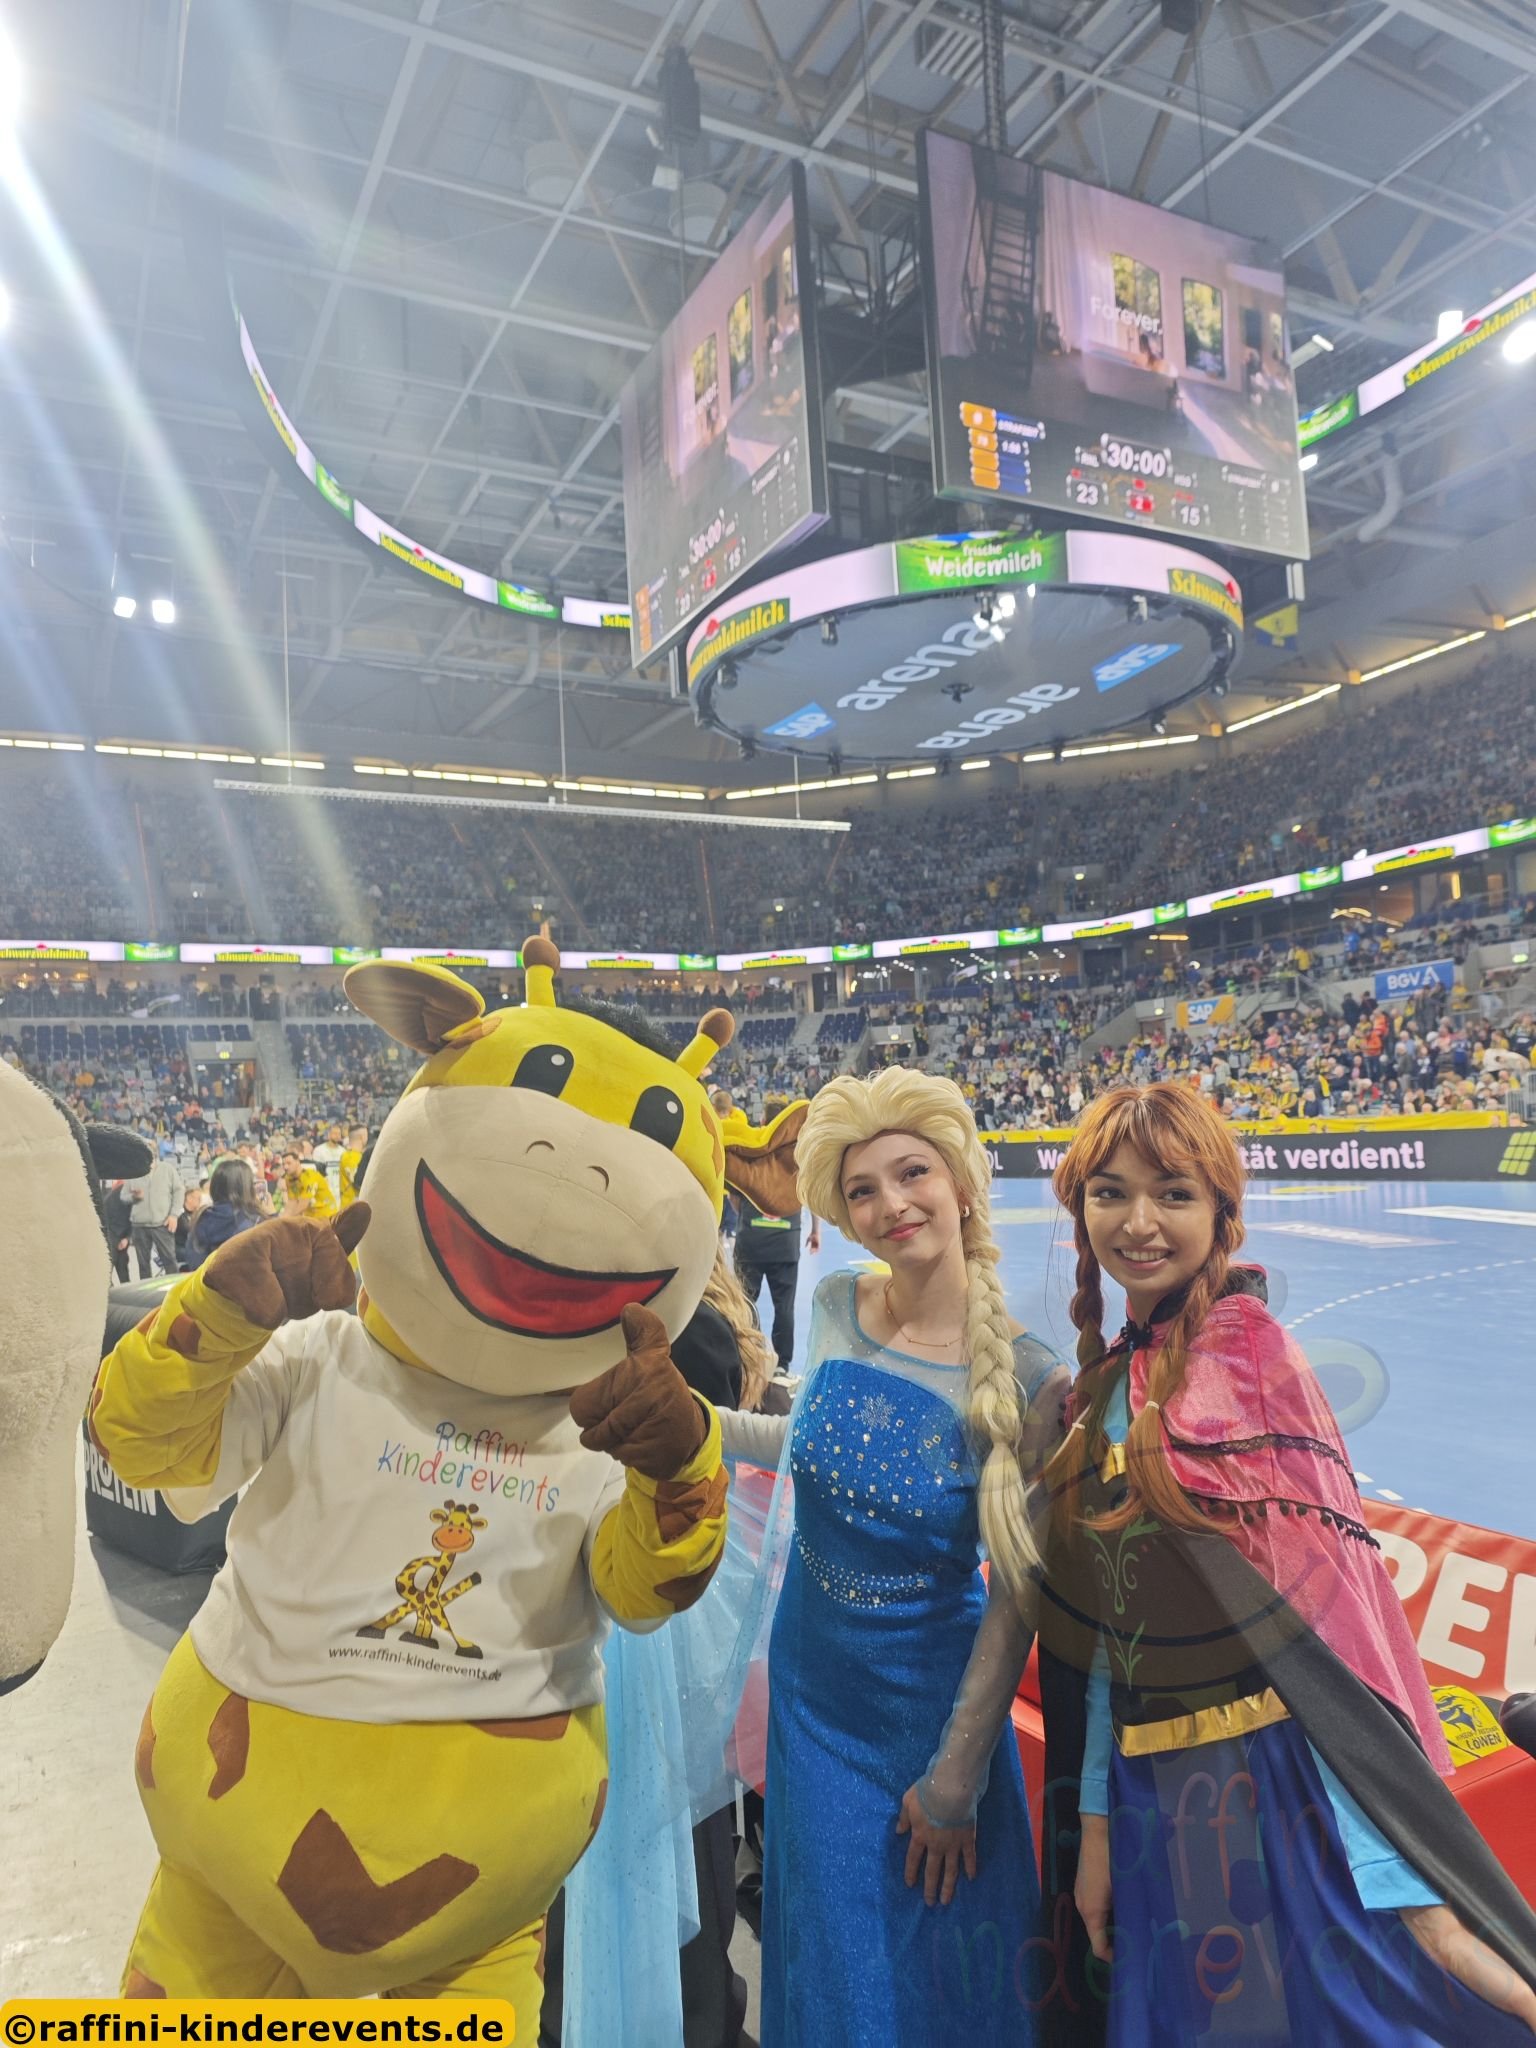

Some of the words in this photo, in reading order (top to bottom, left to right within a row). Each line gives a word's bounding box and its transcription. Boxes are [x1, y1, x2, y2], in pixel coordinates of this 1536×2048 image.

[1107, 442, 1166, 477] 30:00
[1076, 483, 1098, 506] 23
[1180, 506, 1200, 526] 15
[925, 549, 1042, 577] Weidemilch
[837, 620, 1004, 711] arena
[1096, 643, 1169, 681] SAP
[773, 712, 831, 738] SAP
[916, 683, 1080, 748] arena
[1387, 971, 1420, 990] BGV
[1188, 1004, 1213, 1022] SAP
[1284, 1139, 1425, 1169] verdient!
[435, 1421, 528, 1467] Raffini
[378, 1439, 560, 1512] Kinderevents
